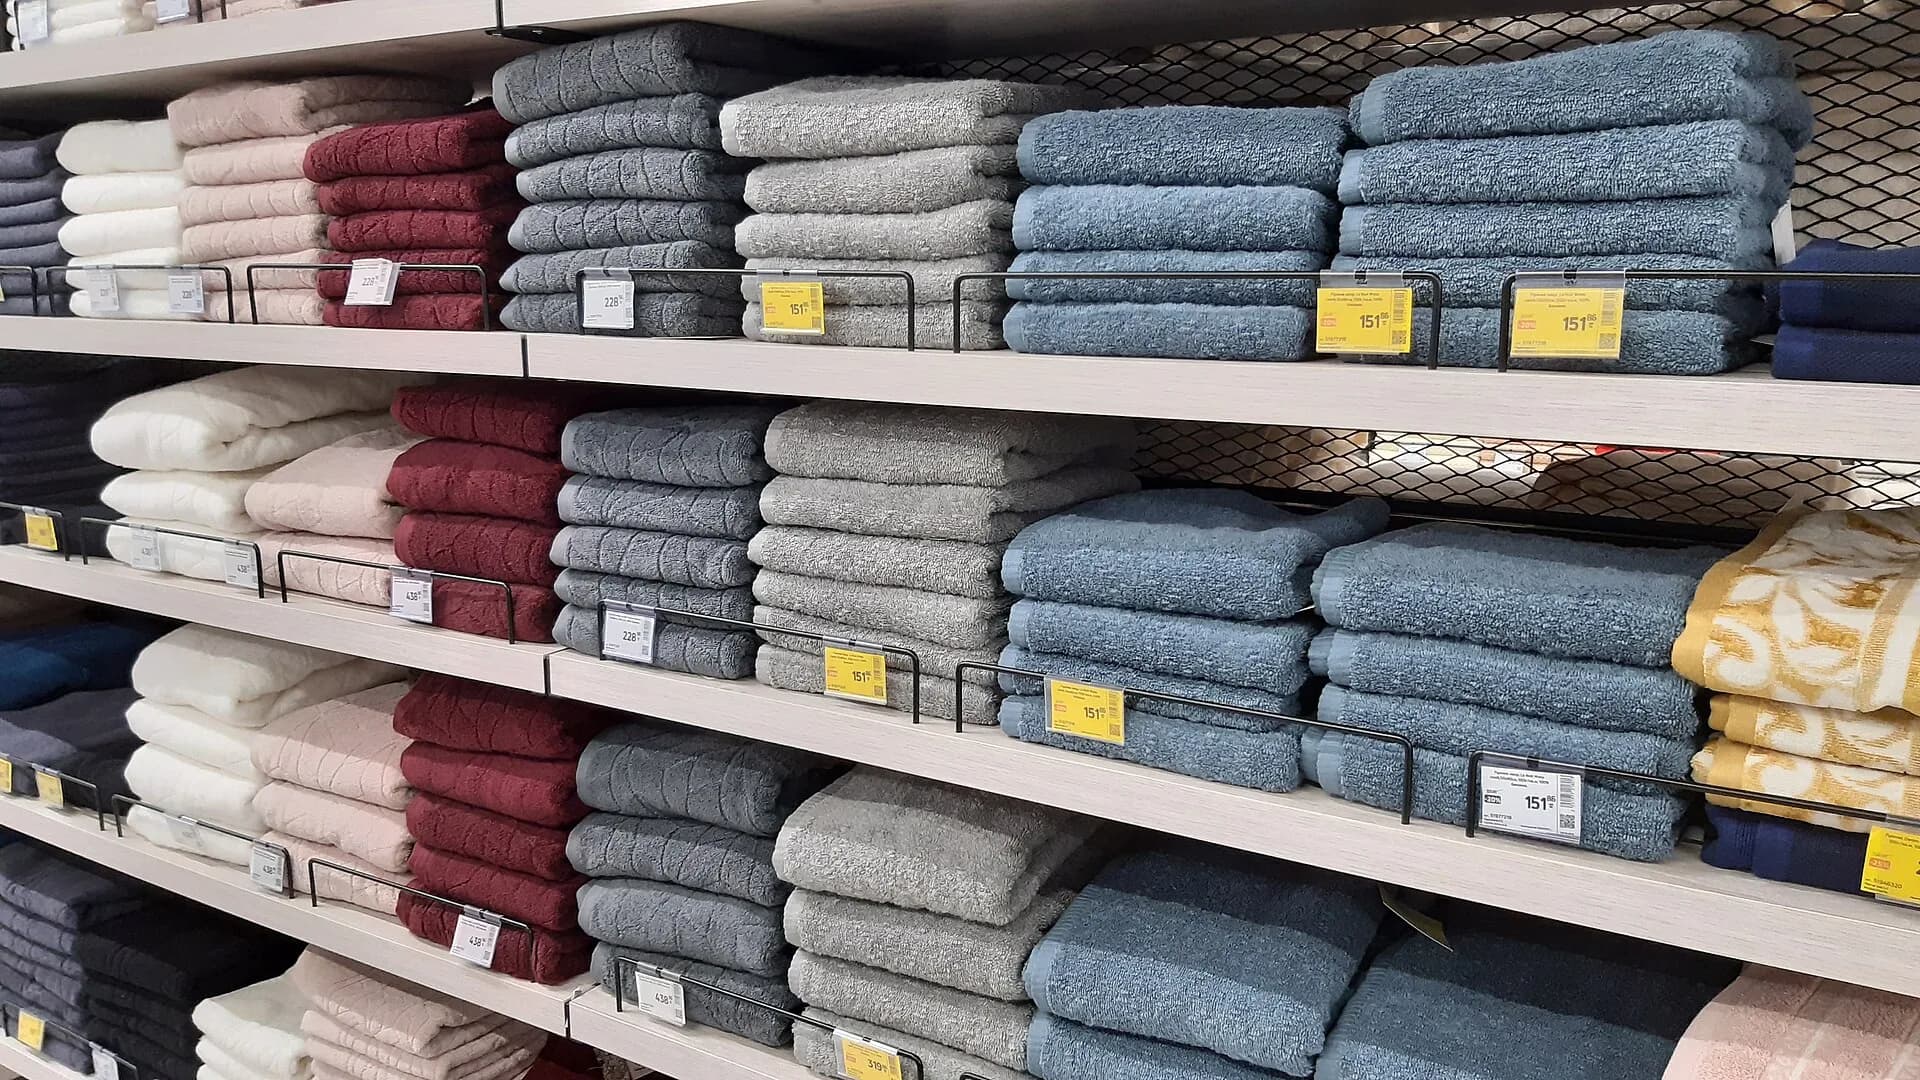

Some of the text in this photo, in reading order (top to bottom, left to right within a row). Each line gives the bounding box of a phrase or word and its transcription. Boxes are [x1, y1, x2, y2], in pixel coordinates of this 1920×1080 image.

[604, 296, 619, 308] 228
[790, 303, 804, 315] 151
[1360, 314, 1380, 329] 151
[1562, 316, 1586, 331] 151
[623, 630, 637, 642] 228
[852, 671, 866, 683] 151
[1083, 706, 1100, 720] 151
[1525, 795, 1547, 811] 151
[469, 935, 482, 947] 438
[655, 992, 669, 1005] 438
[867, 1058, 882, 1071] 319
